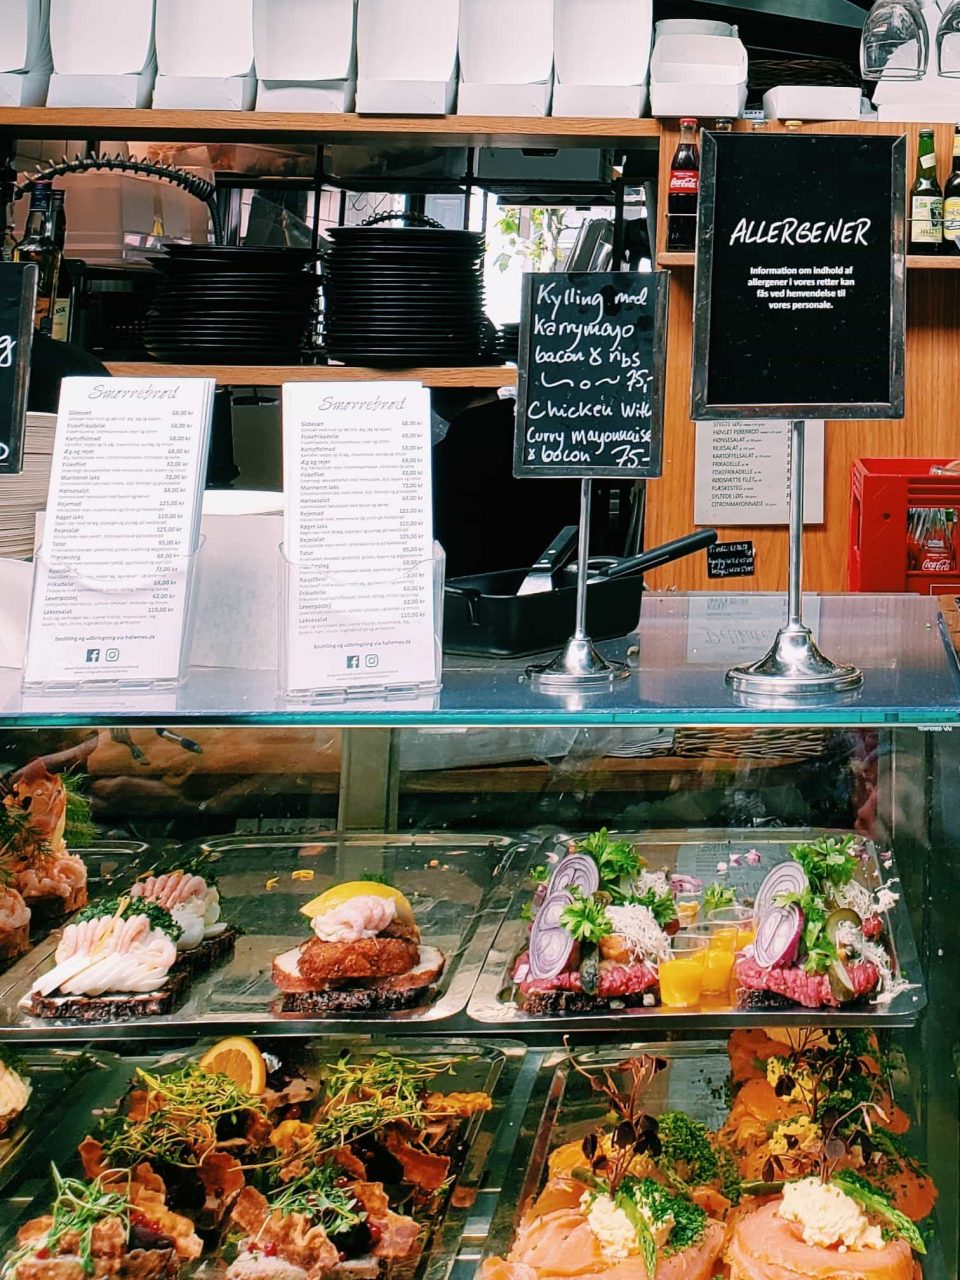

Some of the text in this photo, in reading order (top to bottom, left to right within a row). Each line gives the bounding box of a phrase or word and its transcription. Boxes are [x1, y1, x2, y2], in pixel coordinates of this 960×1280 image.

[729, 217, 872, 246] ALLERGENER
[750, 265, 853, 275] Information om indhold af
[747, 278, 788, 288] allergener
[817, 278, 839, 286] retter
[840, 277, 855, 286] kan
[537, 282, 648, 324] Kylling med
[770, 289, 785, 297] ved
[786, 289, 836, 298] henvendelse
[792, 300, 834, 311] personale.
[535, 345, 585, 364] bacon
[609, 348, 641, 368] ribs
[527, 400, 613, 420] Chicken
[526, 427, 565, 452] Curry
[541, 444, 591, 462] bacon
